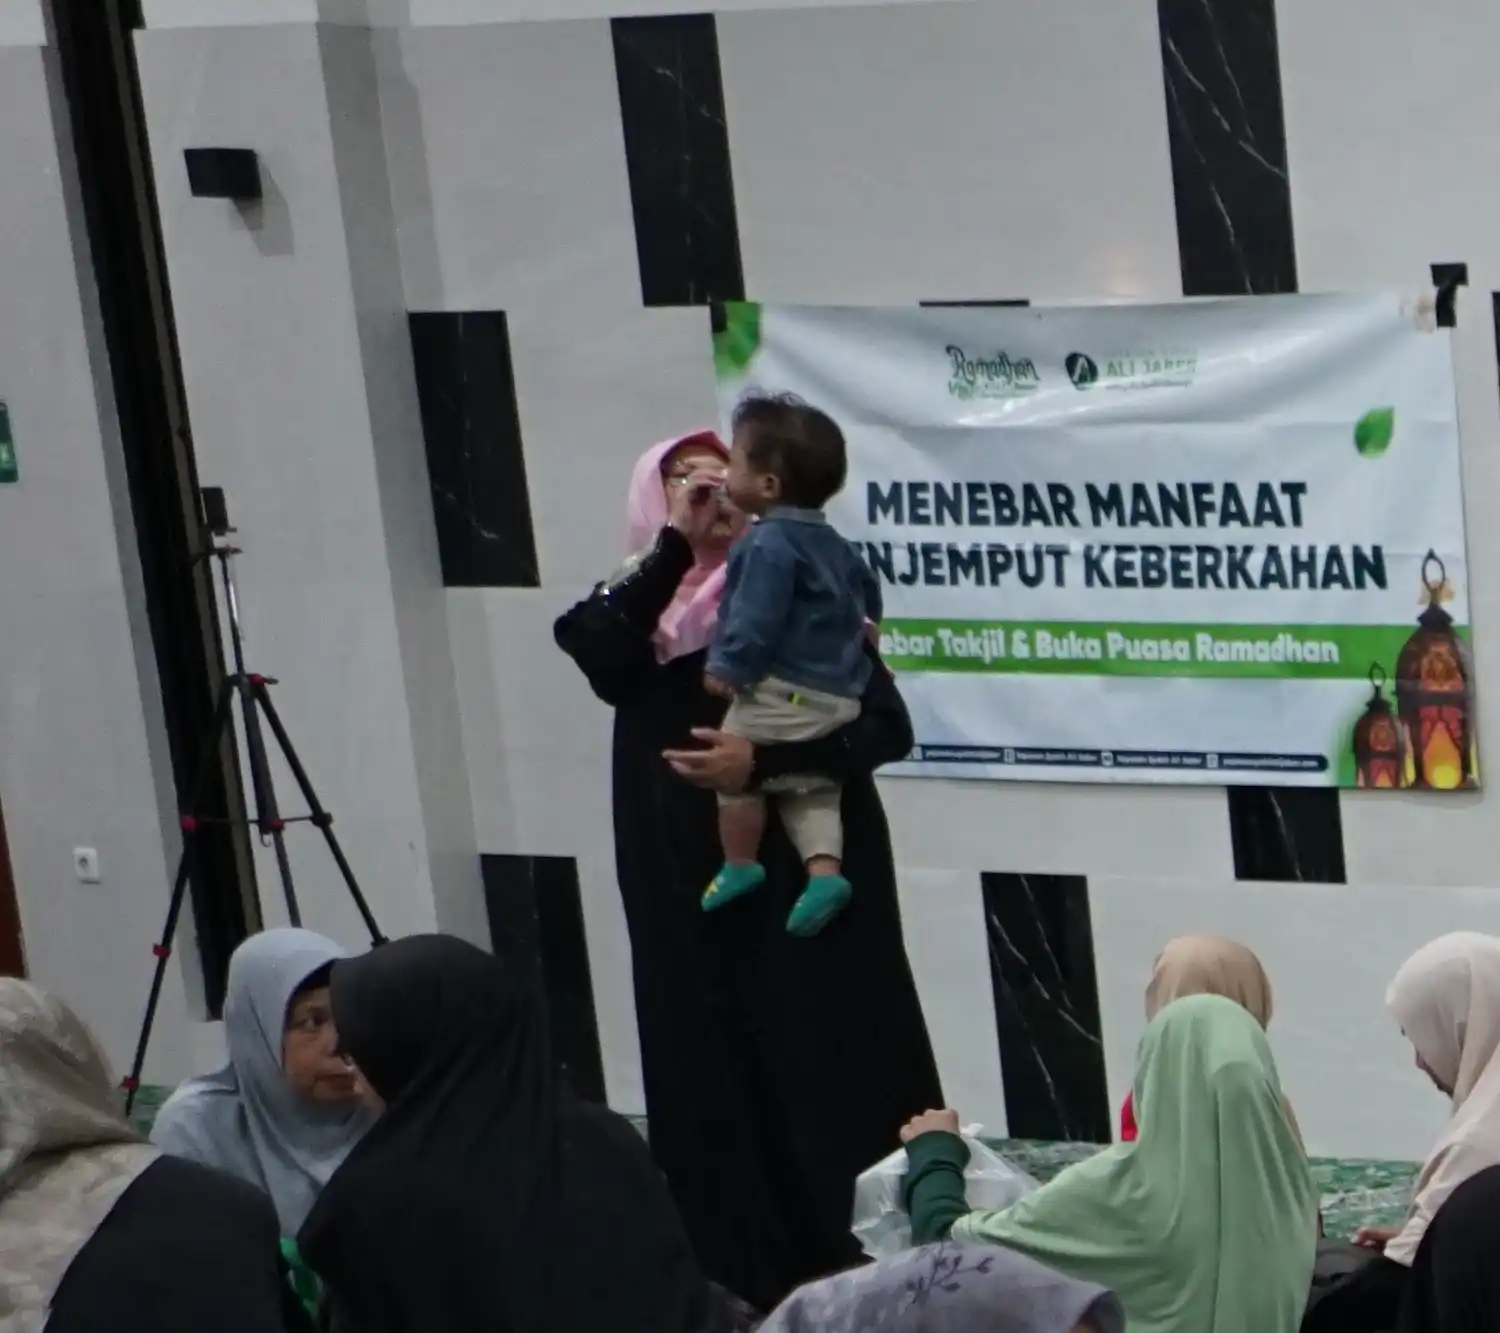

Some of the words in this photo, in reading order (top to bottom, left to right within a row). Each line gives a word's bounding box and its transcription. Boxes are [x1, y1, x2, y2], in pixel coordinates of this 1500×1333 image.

[867, 481, 1080, 528] MENEBAR
[1085, 481, 1308, 528] MANFAAT
[852, 541, 1071, 588] NJEMPUT
[1083, 544, 1388, 590] KEBERKAHAN
[879, 629, 934, 656] ebar
[937, 627, 1006, 665] Takjil
[1012, 628, 1030, 659] &
[1035, 629, 1102, 660] Buka
[1106, 631, 1190, 661] Puasa
[1195, 632, 1340, 664] Ramadhan
